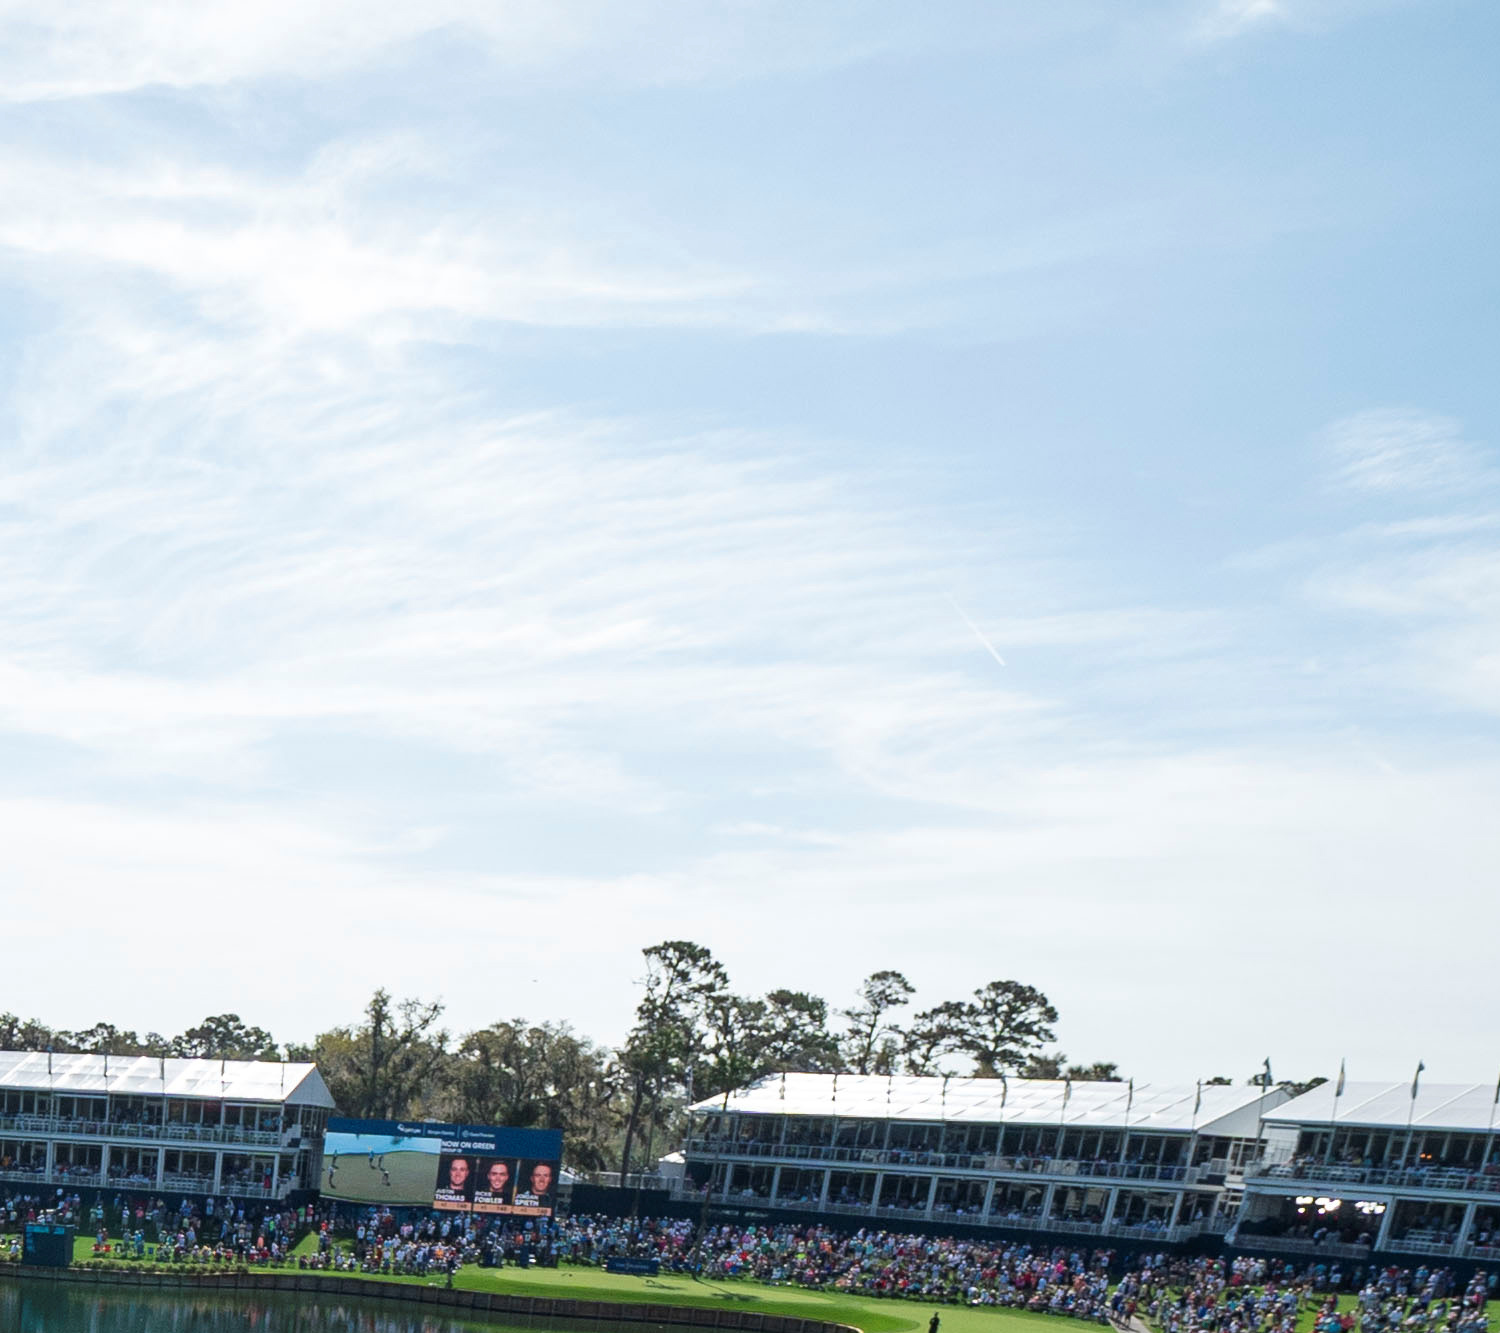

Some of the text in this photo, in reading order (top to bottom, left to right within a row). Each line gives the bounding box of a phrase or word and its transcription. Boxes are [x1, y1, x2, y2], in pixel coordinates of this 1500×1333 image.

[441, 1140, 459, 1148] NOW
[472, 1142, 496, 1150] GREEN
[435, 1194, 465, 1202] THOMAS
